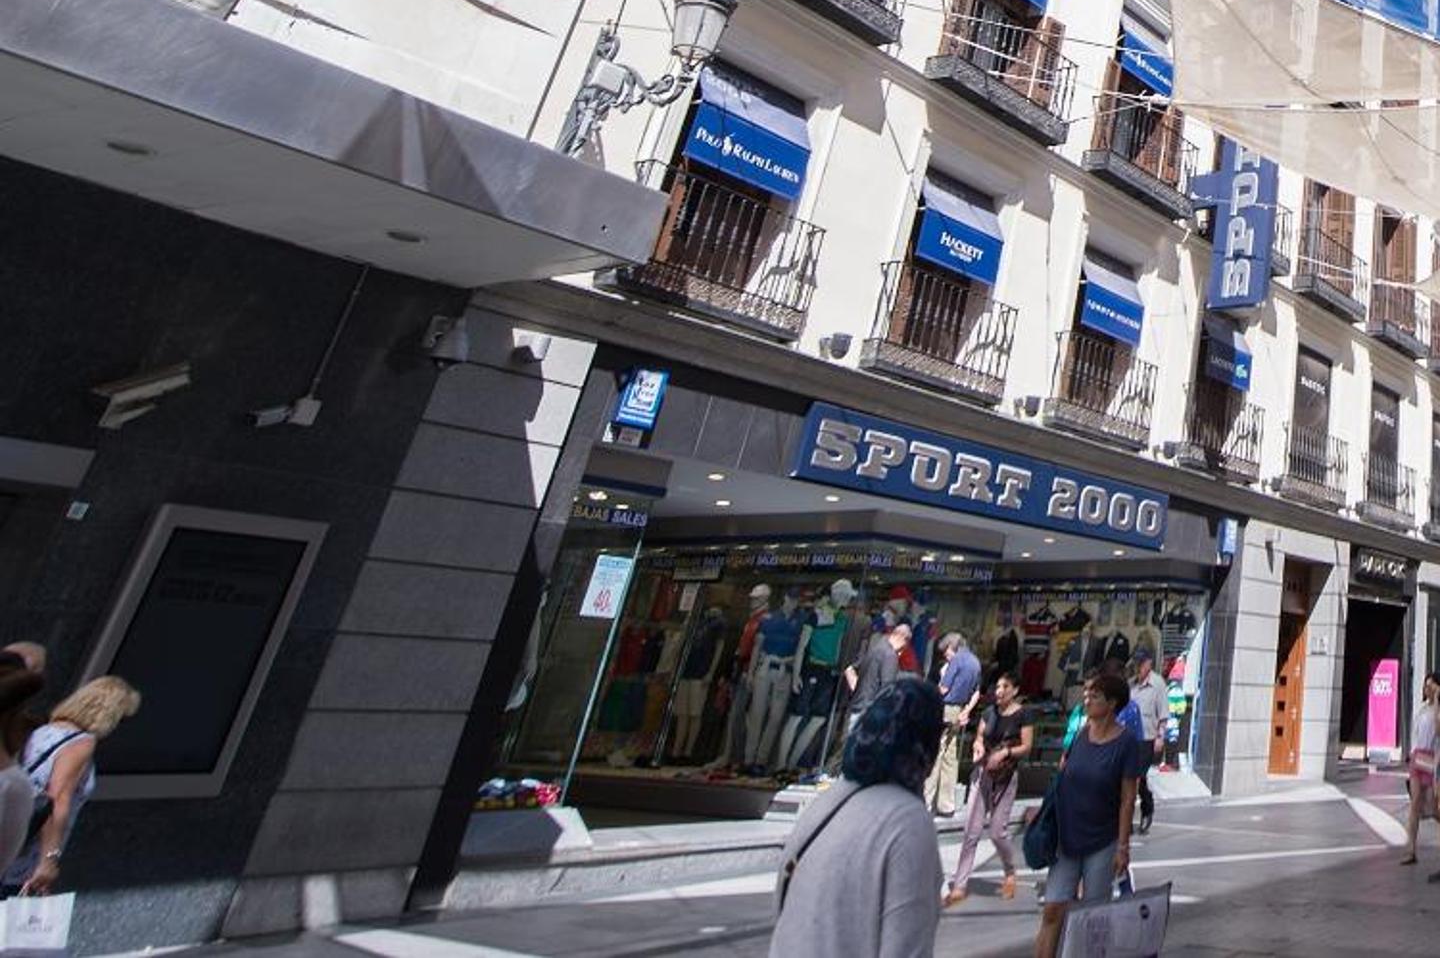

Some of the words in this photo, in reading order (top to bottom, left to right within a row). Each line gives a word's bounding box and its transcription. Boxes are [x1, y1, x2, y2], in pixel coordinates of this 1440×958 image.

[940, 231, 984, 261] HACKETT
[810, 418, 1032, 511] SPORT
[1048, 476, 1162, 537] 2000
